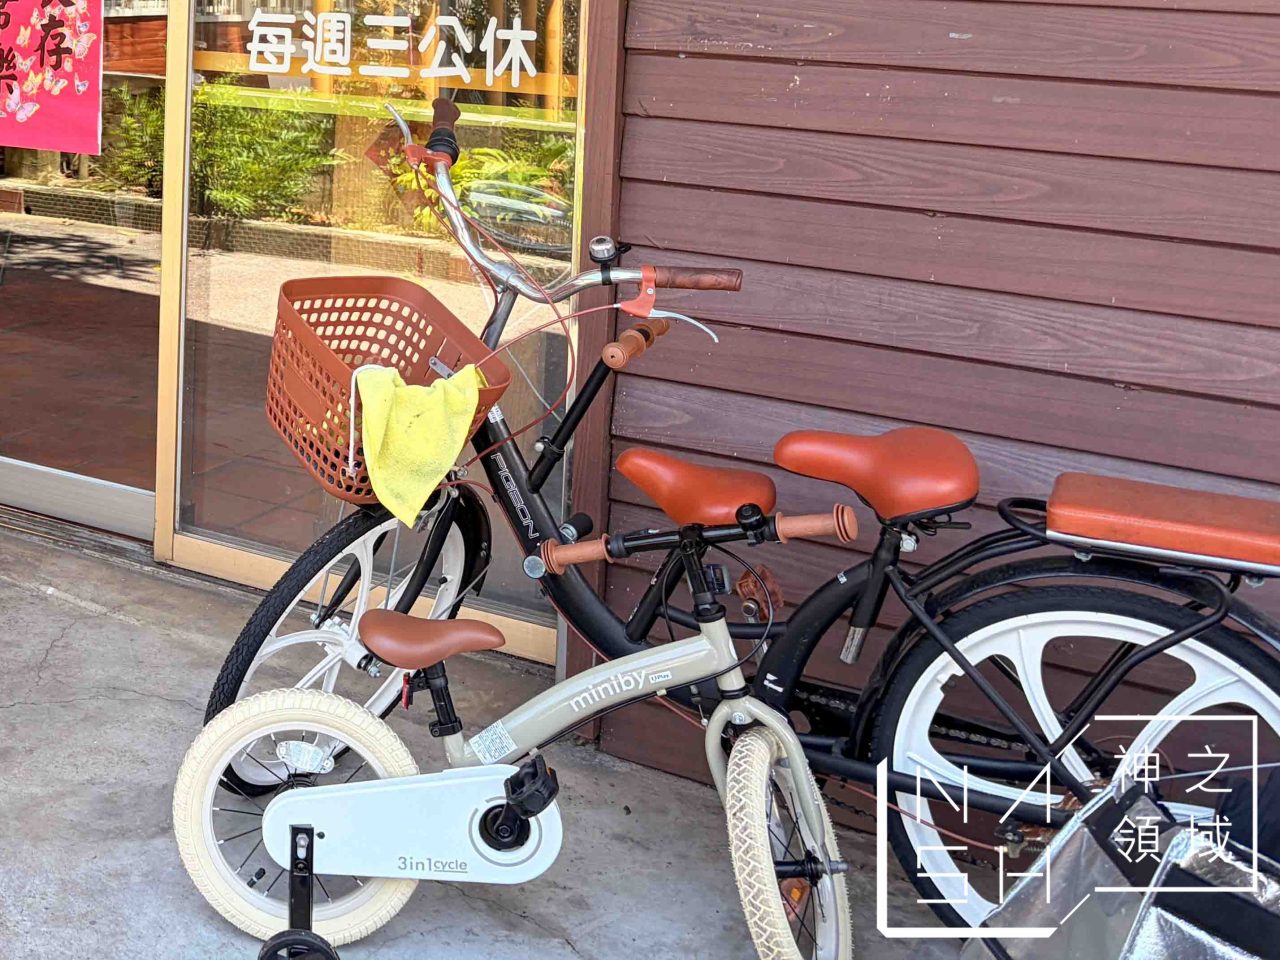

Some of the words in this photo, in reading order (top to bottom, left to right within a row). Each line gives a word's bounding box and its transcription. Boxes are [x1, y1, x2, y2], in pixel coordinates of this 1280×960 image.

[246, 8, 538, 88] 每週三公休
[490, 453, 540, 539] PIGEON
[568, 669, 646, 712] miniby
